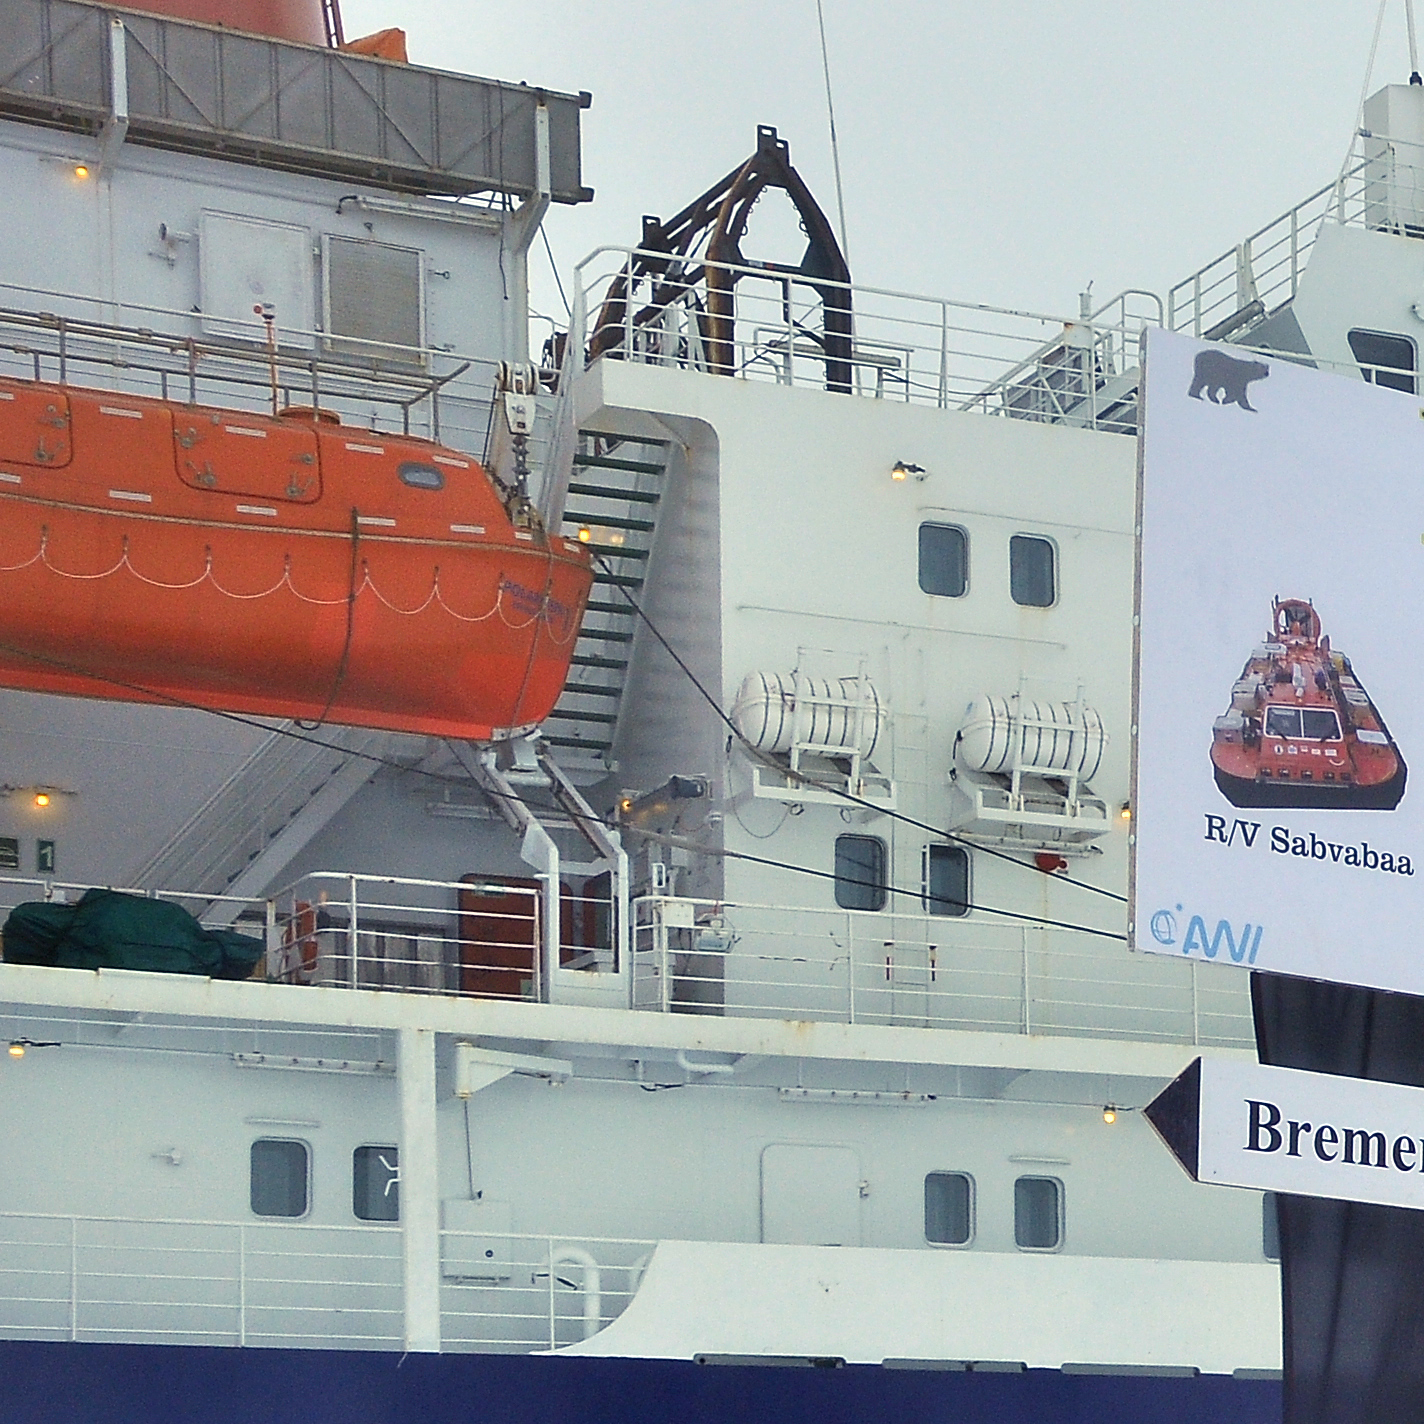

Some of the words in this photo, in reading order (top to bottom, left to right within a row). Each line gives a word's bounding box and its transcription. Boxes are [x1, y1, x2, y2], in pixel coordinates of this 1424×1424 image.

[1204, 814, 1262, 847] R/V
[1271, 826, 1415, 876] Sabvabaa
[1182, 914, 1263, 965] AWI
